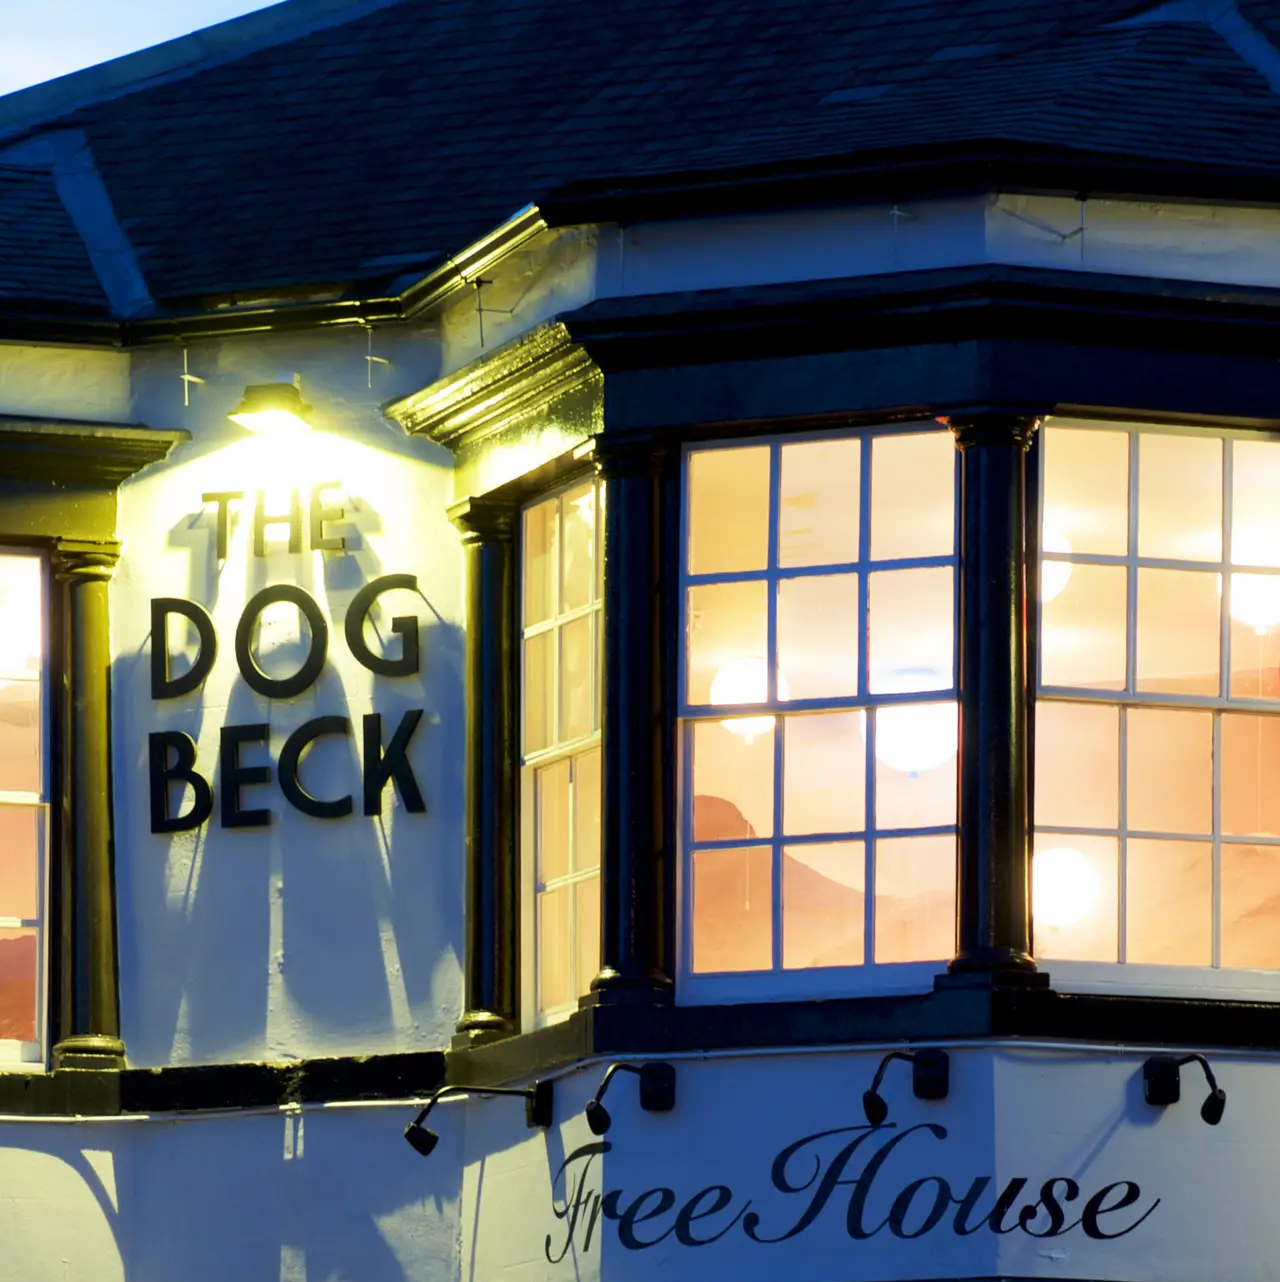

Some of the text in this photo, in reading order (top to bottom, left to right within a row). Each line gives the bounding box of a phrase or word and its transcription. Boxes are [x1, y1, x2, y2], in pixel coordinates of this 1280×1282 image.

[201, 479, 347, 560] THE
[150, 573, 420, 701] DOG
[148, 709, 427, 834] BECK
[545, 1121, 1161, 1265] Free House
